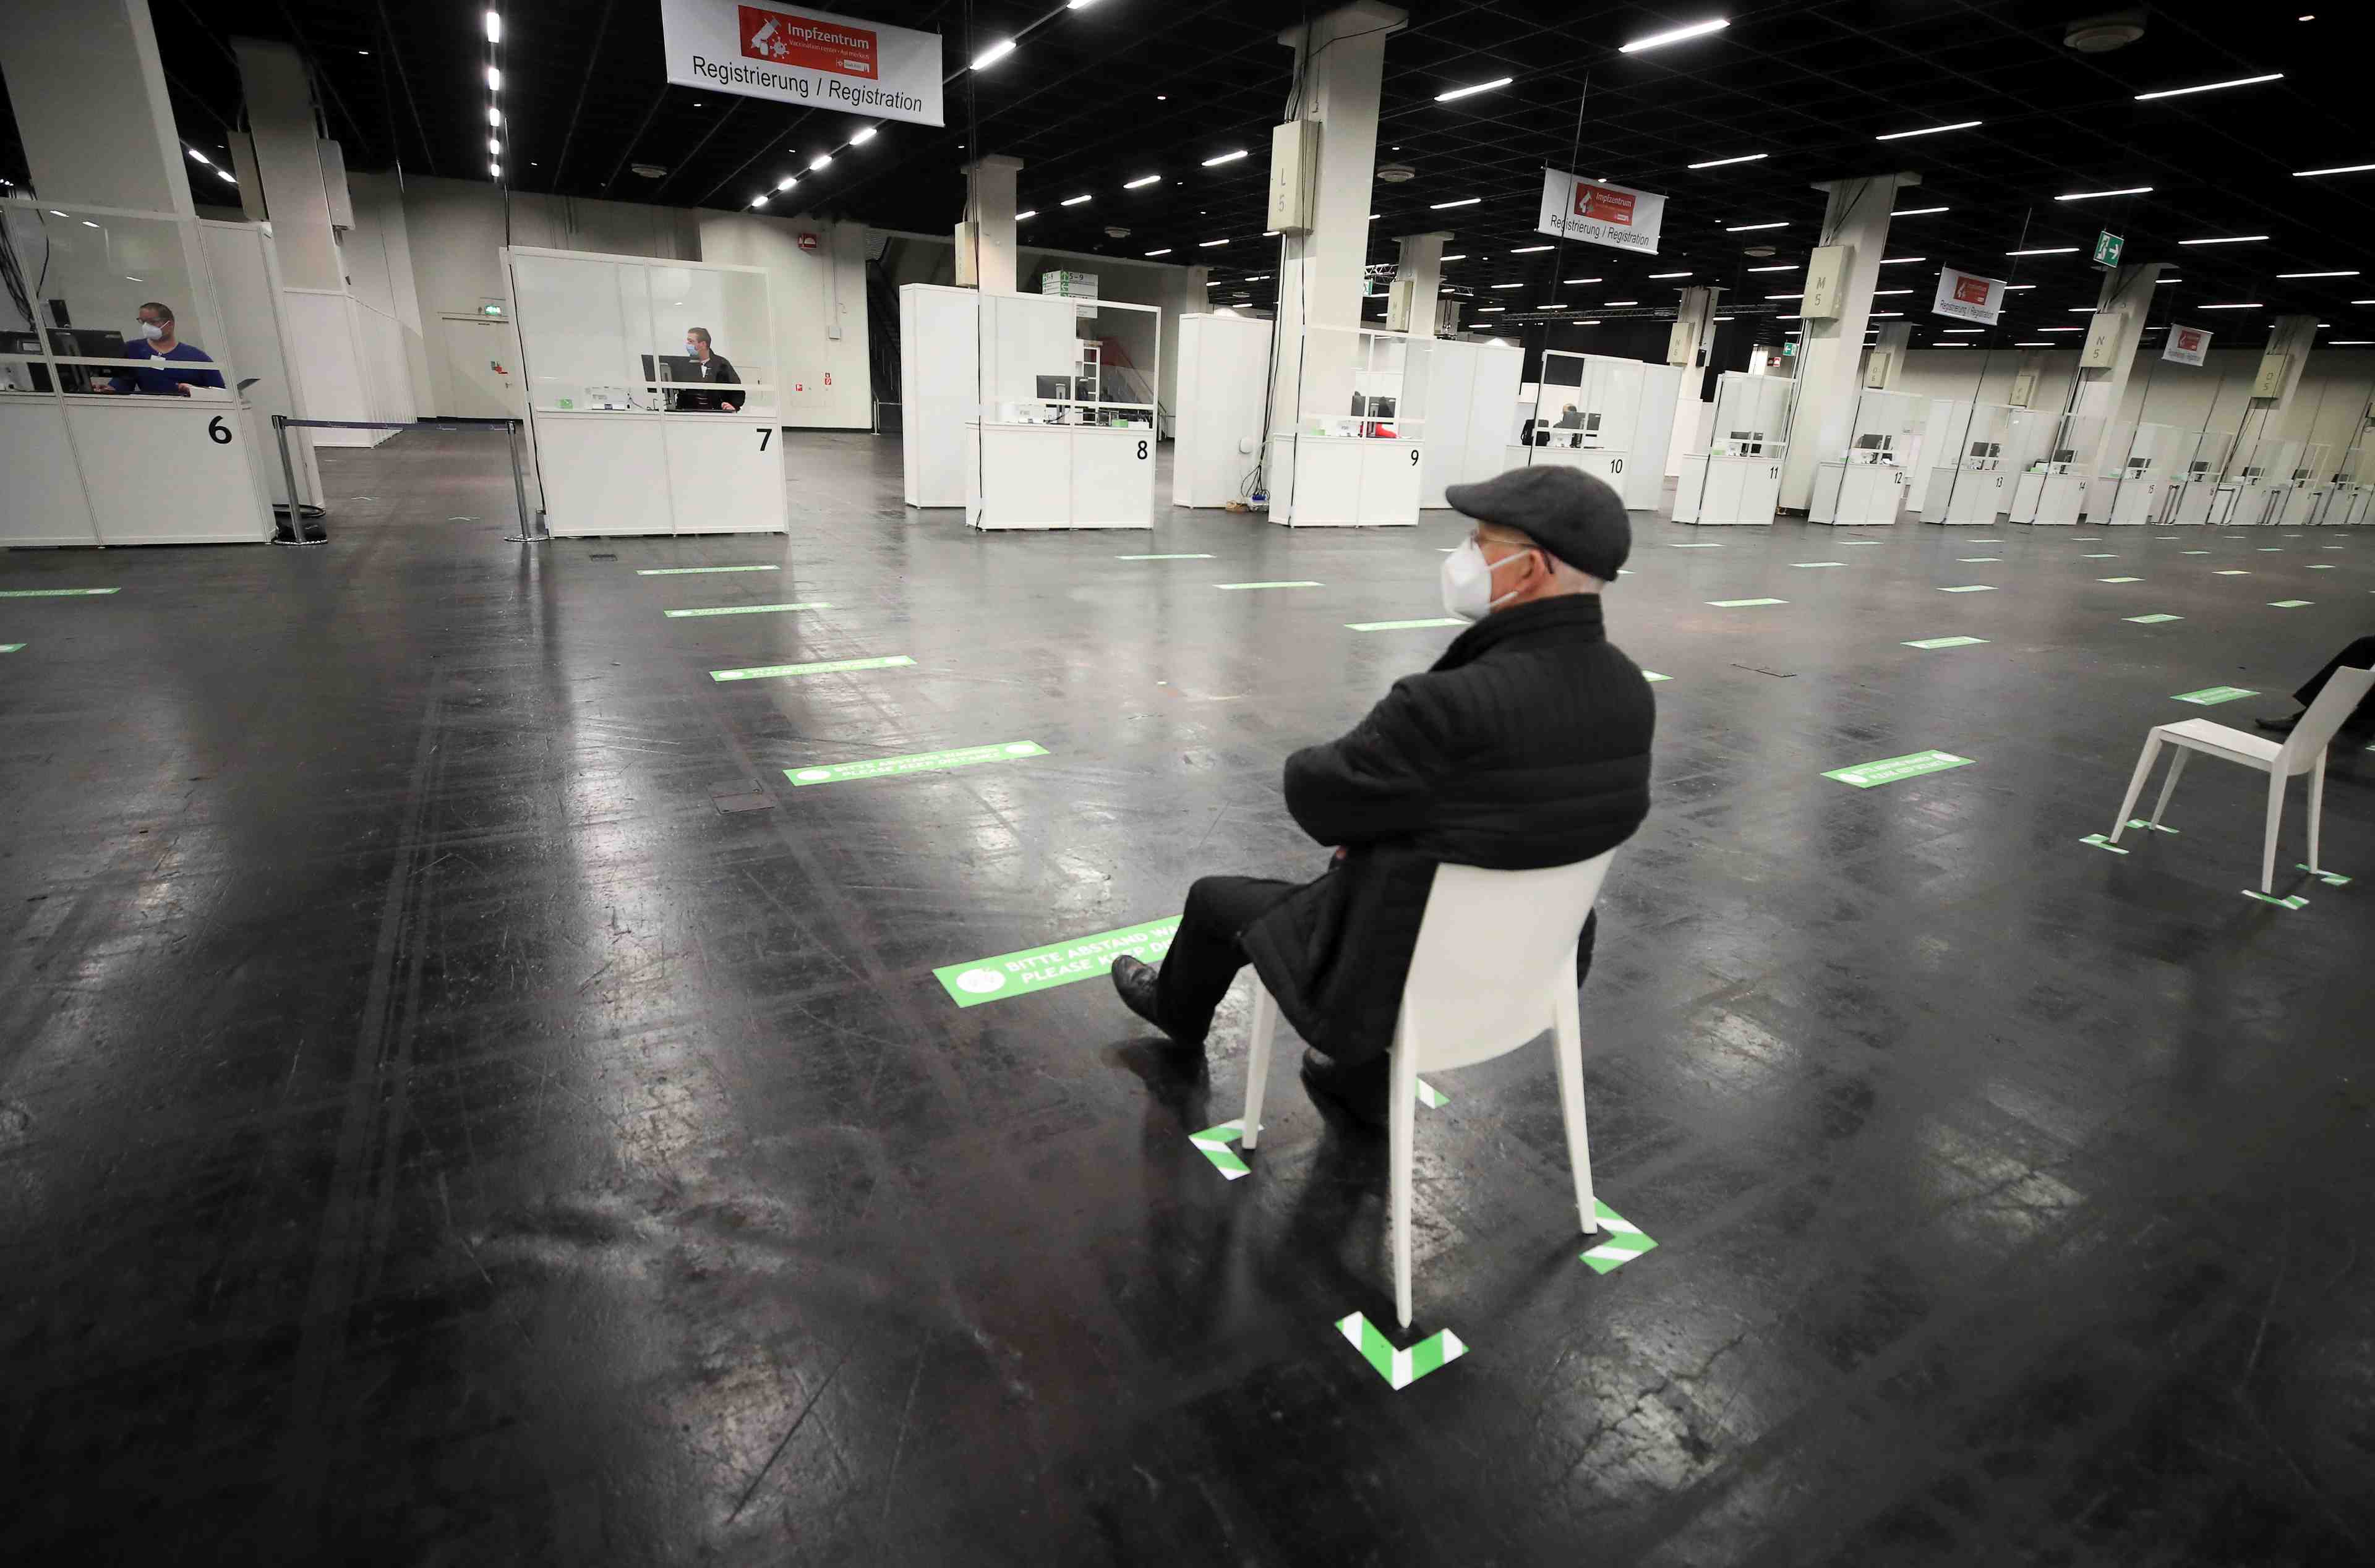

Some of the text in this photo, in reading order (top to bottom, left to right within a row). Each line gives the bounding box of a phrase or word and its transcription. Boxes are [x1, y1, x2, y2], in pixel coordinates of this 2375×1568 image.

[788, 23, 869, 49] Impfzentrum
[693, 55, 922, 112] Registrierung / Registration
[1277, 194, 1285, 212] 5
[1595, 192, 1632, 208] Impfzentrum
[1551, 214, 1601, 239] Registrierung
[1607, 226, 1650, 246] Registration
[1816, 276, 1826, 290] M
[1815, 293, 1821, 306] 5
[2093, 349, 2100, 359] 5
[208, 415, 233, 445] 6
[756, 428, 772, 451] 7
[1137, 440, 1148, 460] 8
[1411, 450, 1419, 467] 9
[1611, 459, 1623, 474] 10
[1769, 466, 1779, 480] 11
[1894, 472, 1903, 484] 12
[1995, 477, 2004, 488] 13
[1004, 952, 1064, 973] BITTE
[1068, 932, 1149, 959] ABSTAND
[1021, 959, 1094, 984] PLEASE
